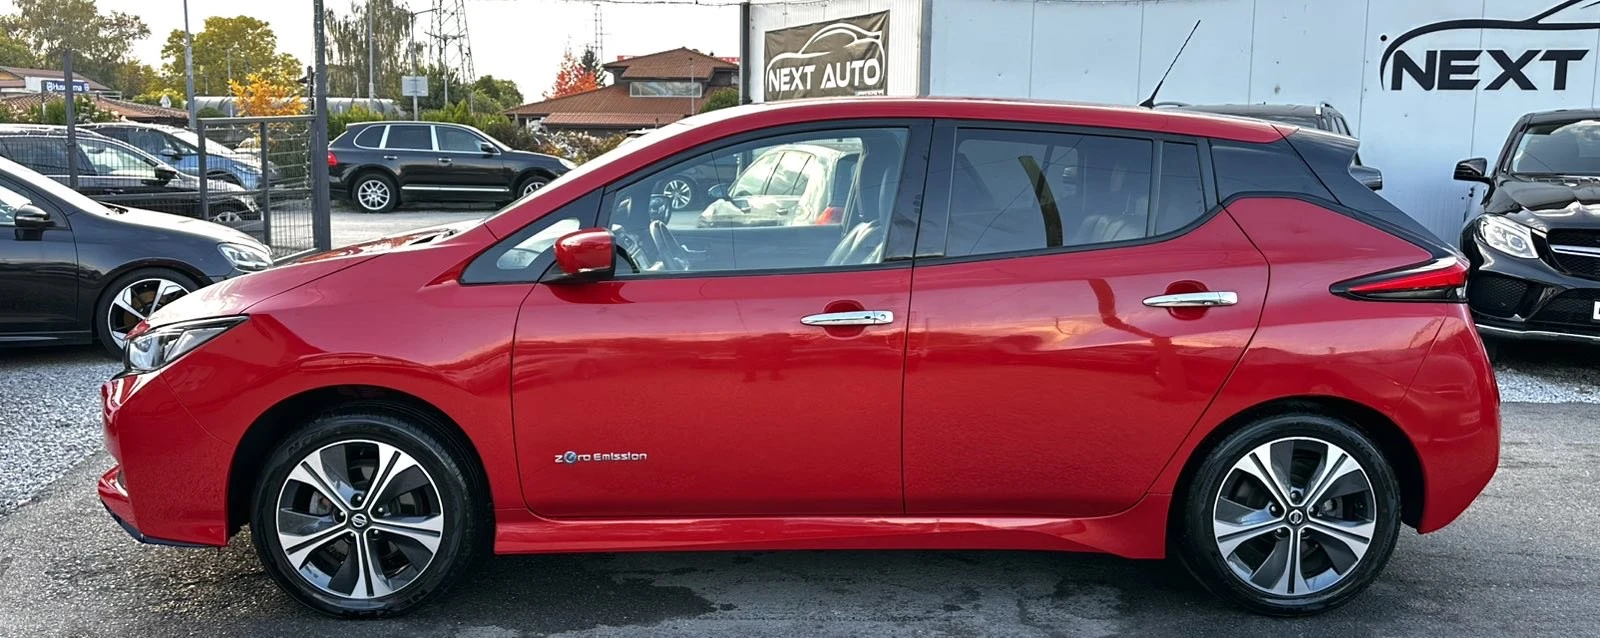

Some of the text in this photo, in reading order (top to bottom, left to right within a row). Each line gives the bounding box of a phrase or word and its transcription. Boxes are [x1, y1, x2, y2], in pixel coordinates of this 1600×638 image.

[768, 58, 881, 92] NEXT AUTO
[1391, 49, 1590, 91] NEXT
